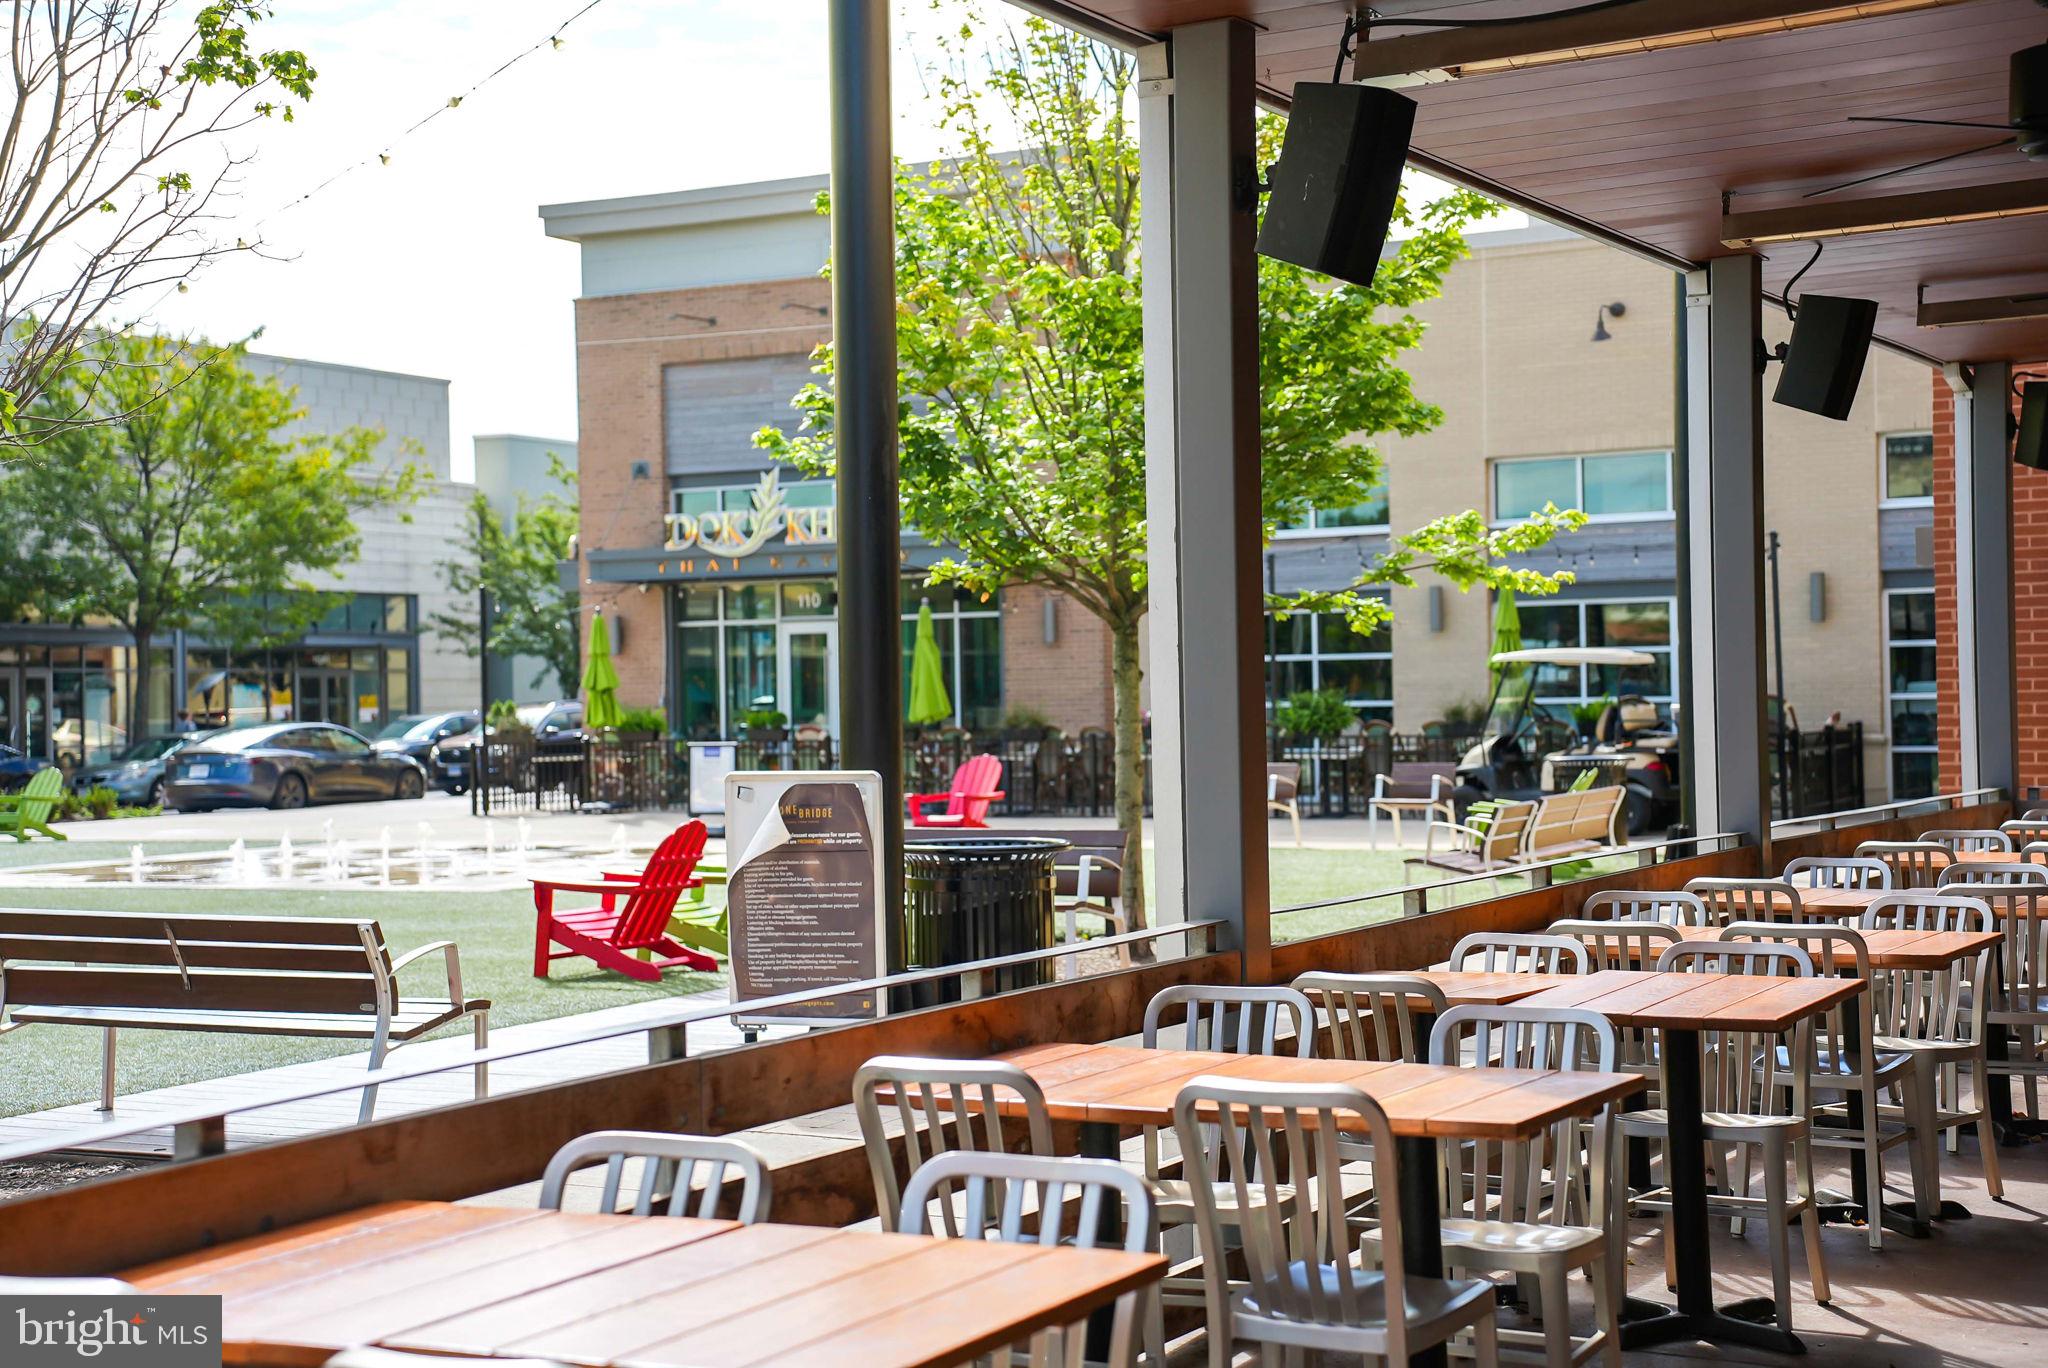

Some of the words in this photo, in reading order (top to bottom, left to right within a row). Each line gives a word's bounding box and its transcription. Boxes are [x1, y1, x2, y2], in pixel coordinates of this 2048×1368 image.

[664, 512, 750, 551] DOK
[784, 506, 837, 545] KH
[658, 556, 741, 574] THAI
[798, 592, 822, 608] 110
[799, 808, 832, 818] BRIDGE
